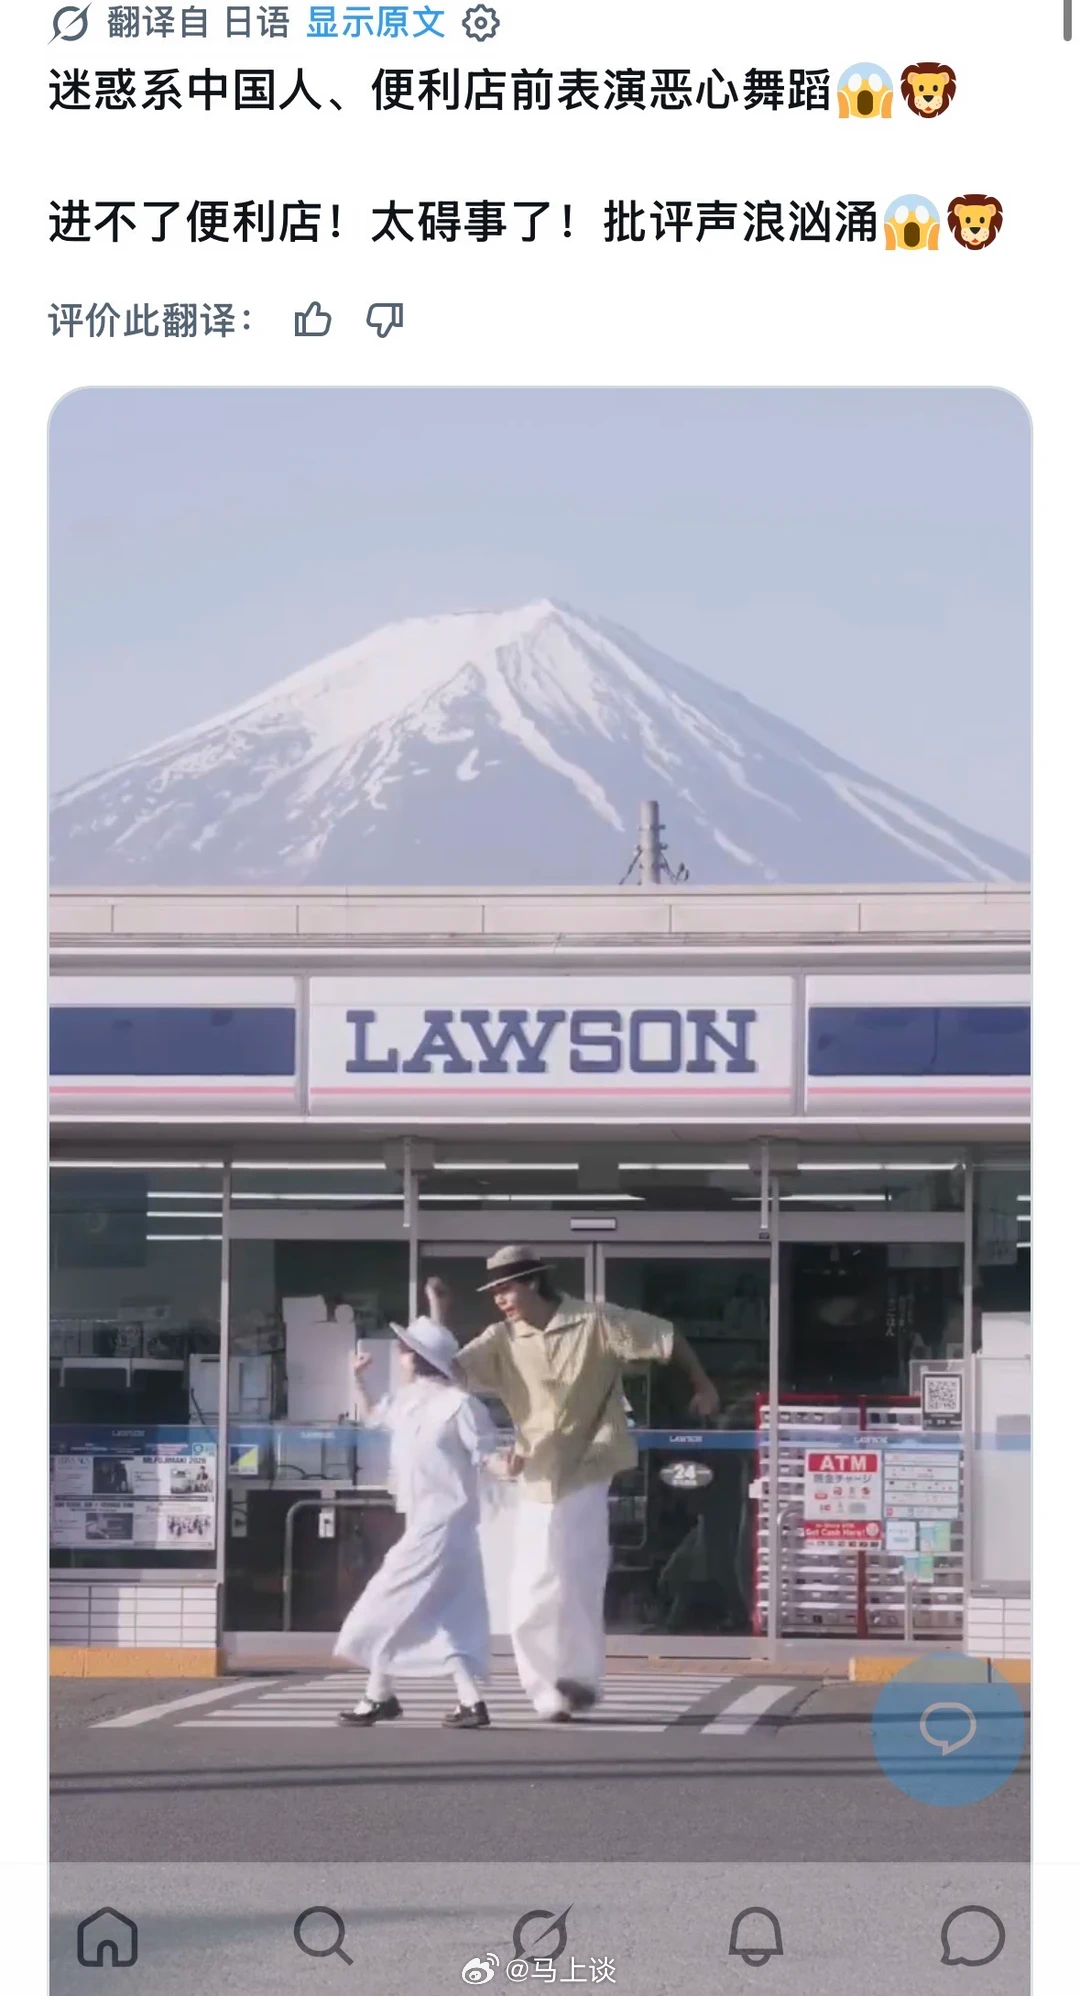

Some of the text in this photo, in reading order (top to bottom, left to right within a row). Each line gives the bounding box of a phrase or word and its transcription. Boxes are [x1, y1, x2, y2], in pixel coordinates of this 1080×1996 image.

[345, 1009, 757, 1074] LAWSON
[819, 1454, 867, 1471] ATM
[673, 1463, 697, 1479] 24
[821, 1527, 841, 1537] Cash
[842, 1527, 866, 1538] Here!
